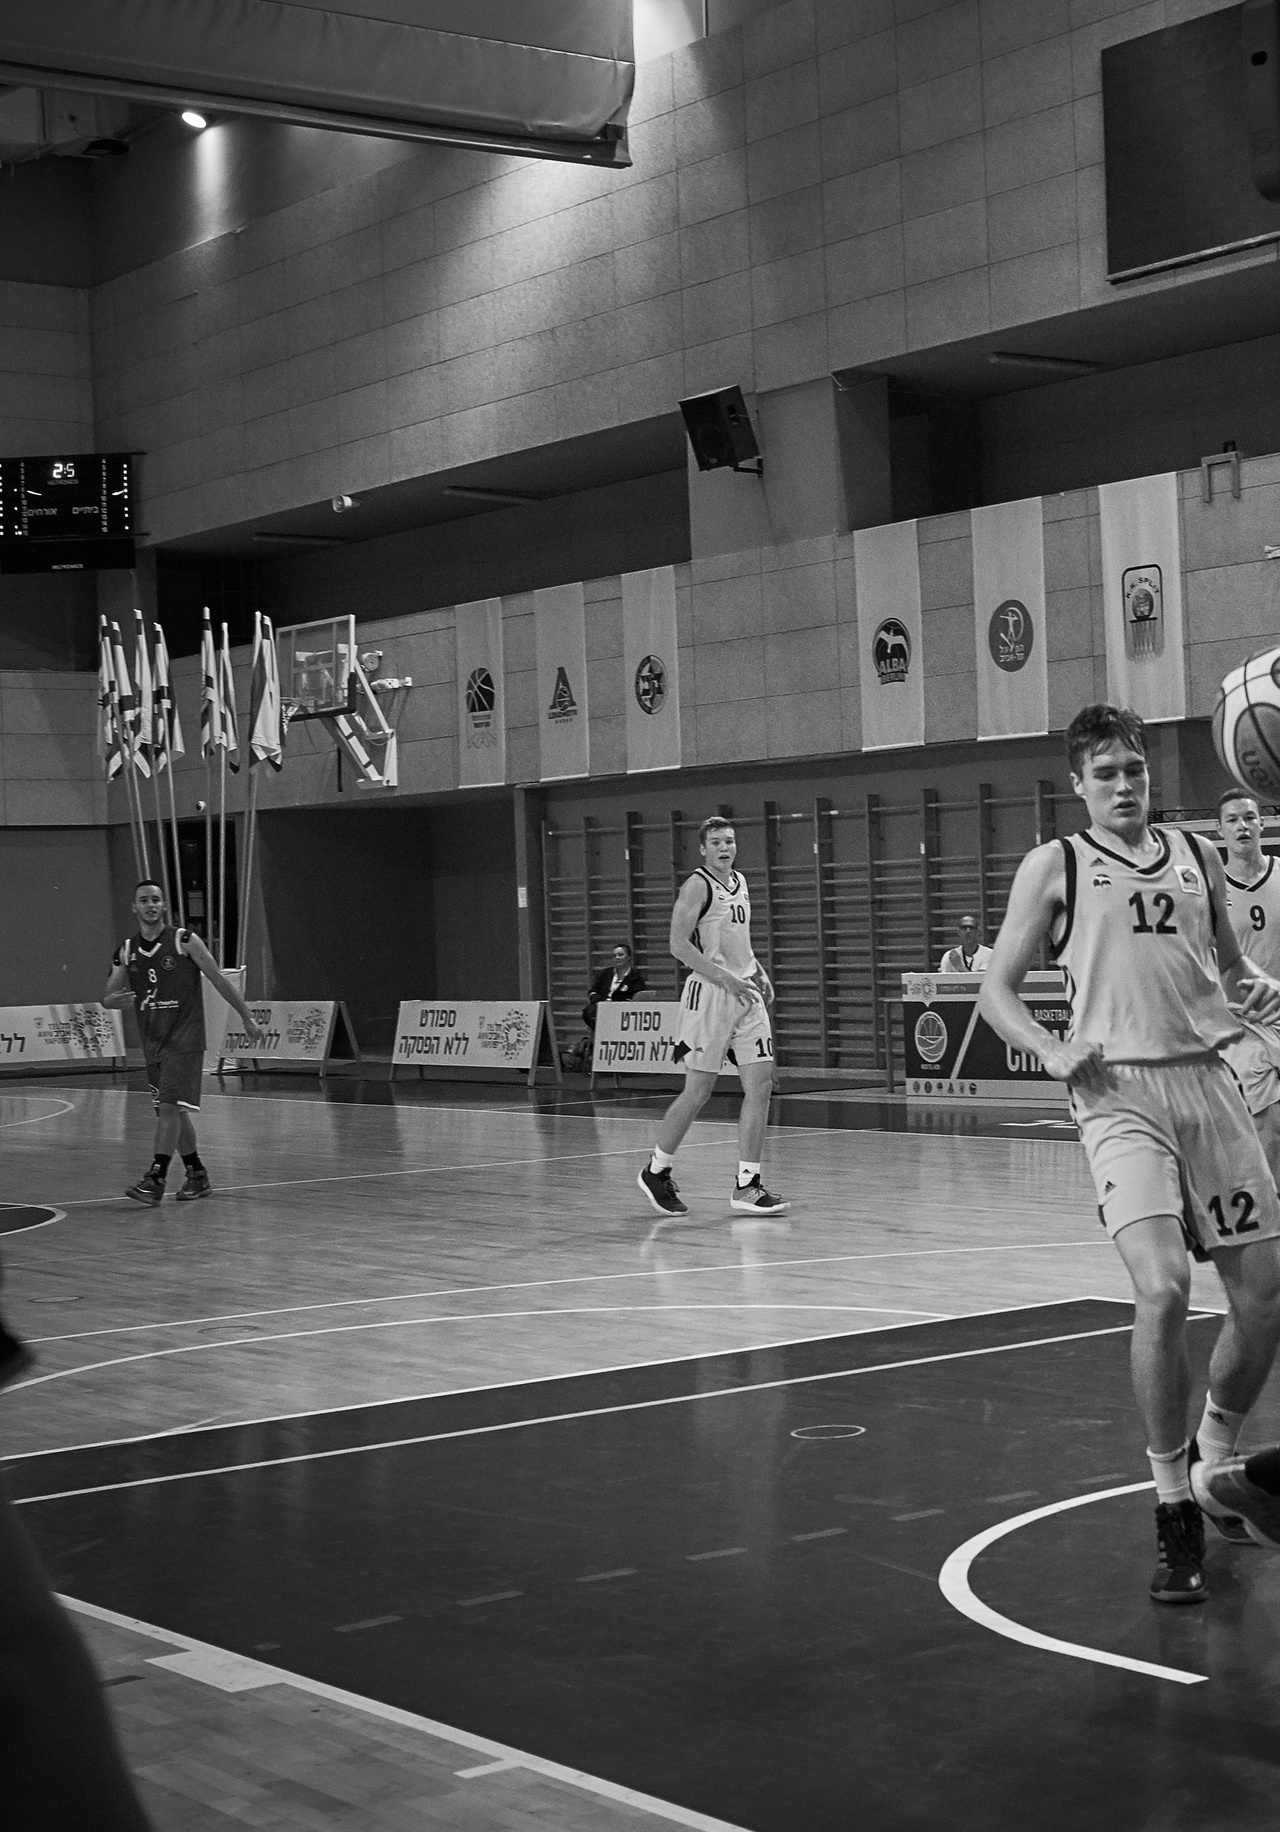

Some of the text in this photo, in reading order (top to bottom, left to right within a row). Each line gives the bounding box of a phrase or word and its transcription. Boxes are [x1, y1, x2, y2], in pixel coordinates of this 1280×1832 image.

[880, 658, 906, 672] ALBA
[730, 904, 746, 924] 10
[1128, 891, 1178, 934] 12
[1249, 904, 1266, 931] 9
[148, 968, 158, 983] 8
[420, 1009, 457, 1028] ספורט
[620, 1011, 661, 1031] ספורט
[0, 1033, 26, 1053] לל
[398, 1035, 442, 1058] הפסקה
[443, 1032, 470, 1056] ללא
[599, 1040, 646, 1066] הפסקה
[1208, 1191, 1260, 1237] 12
